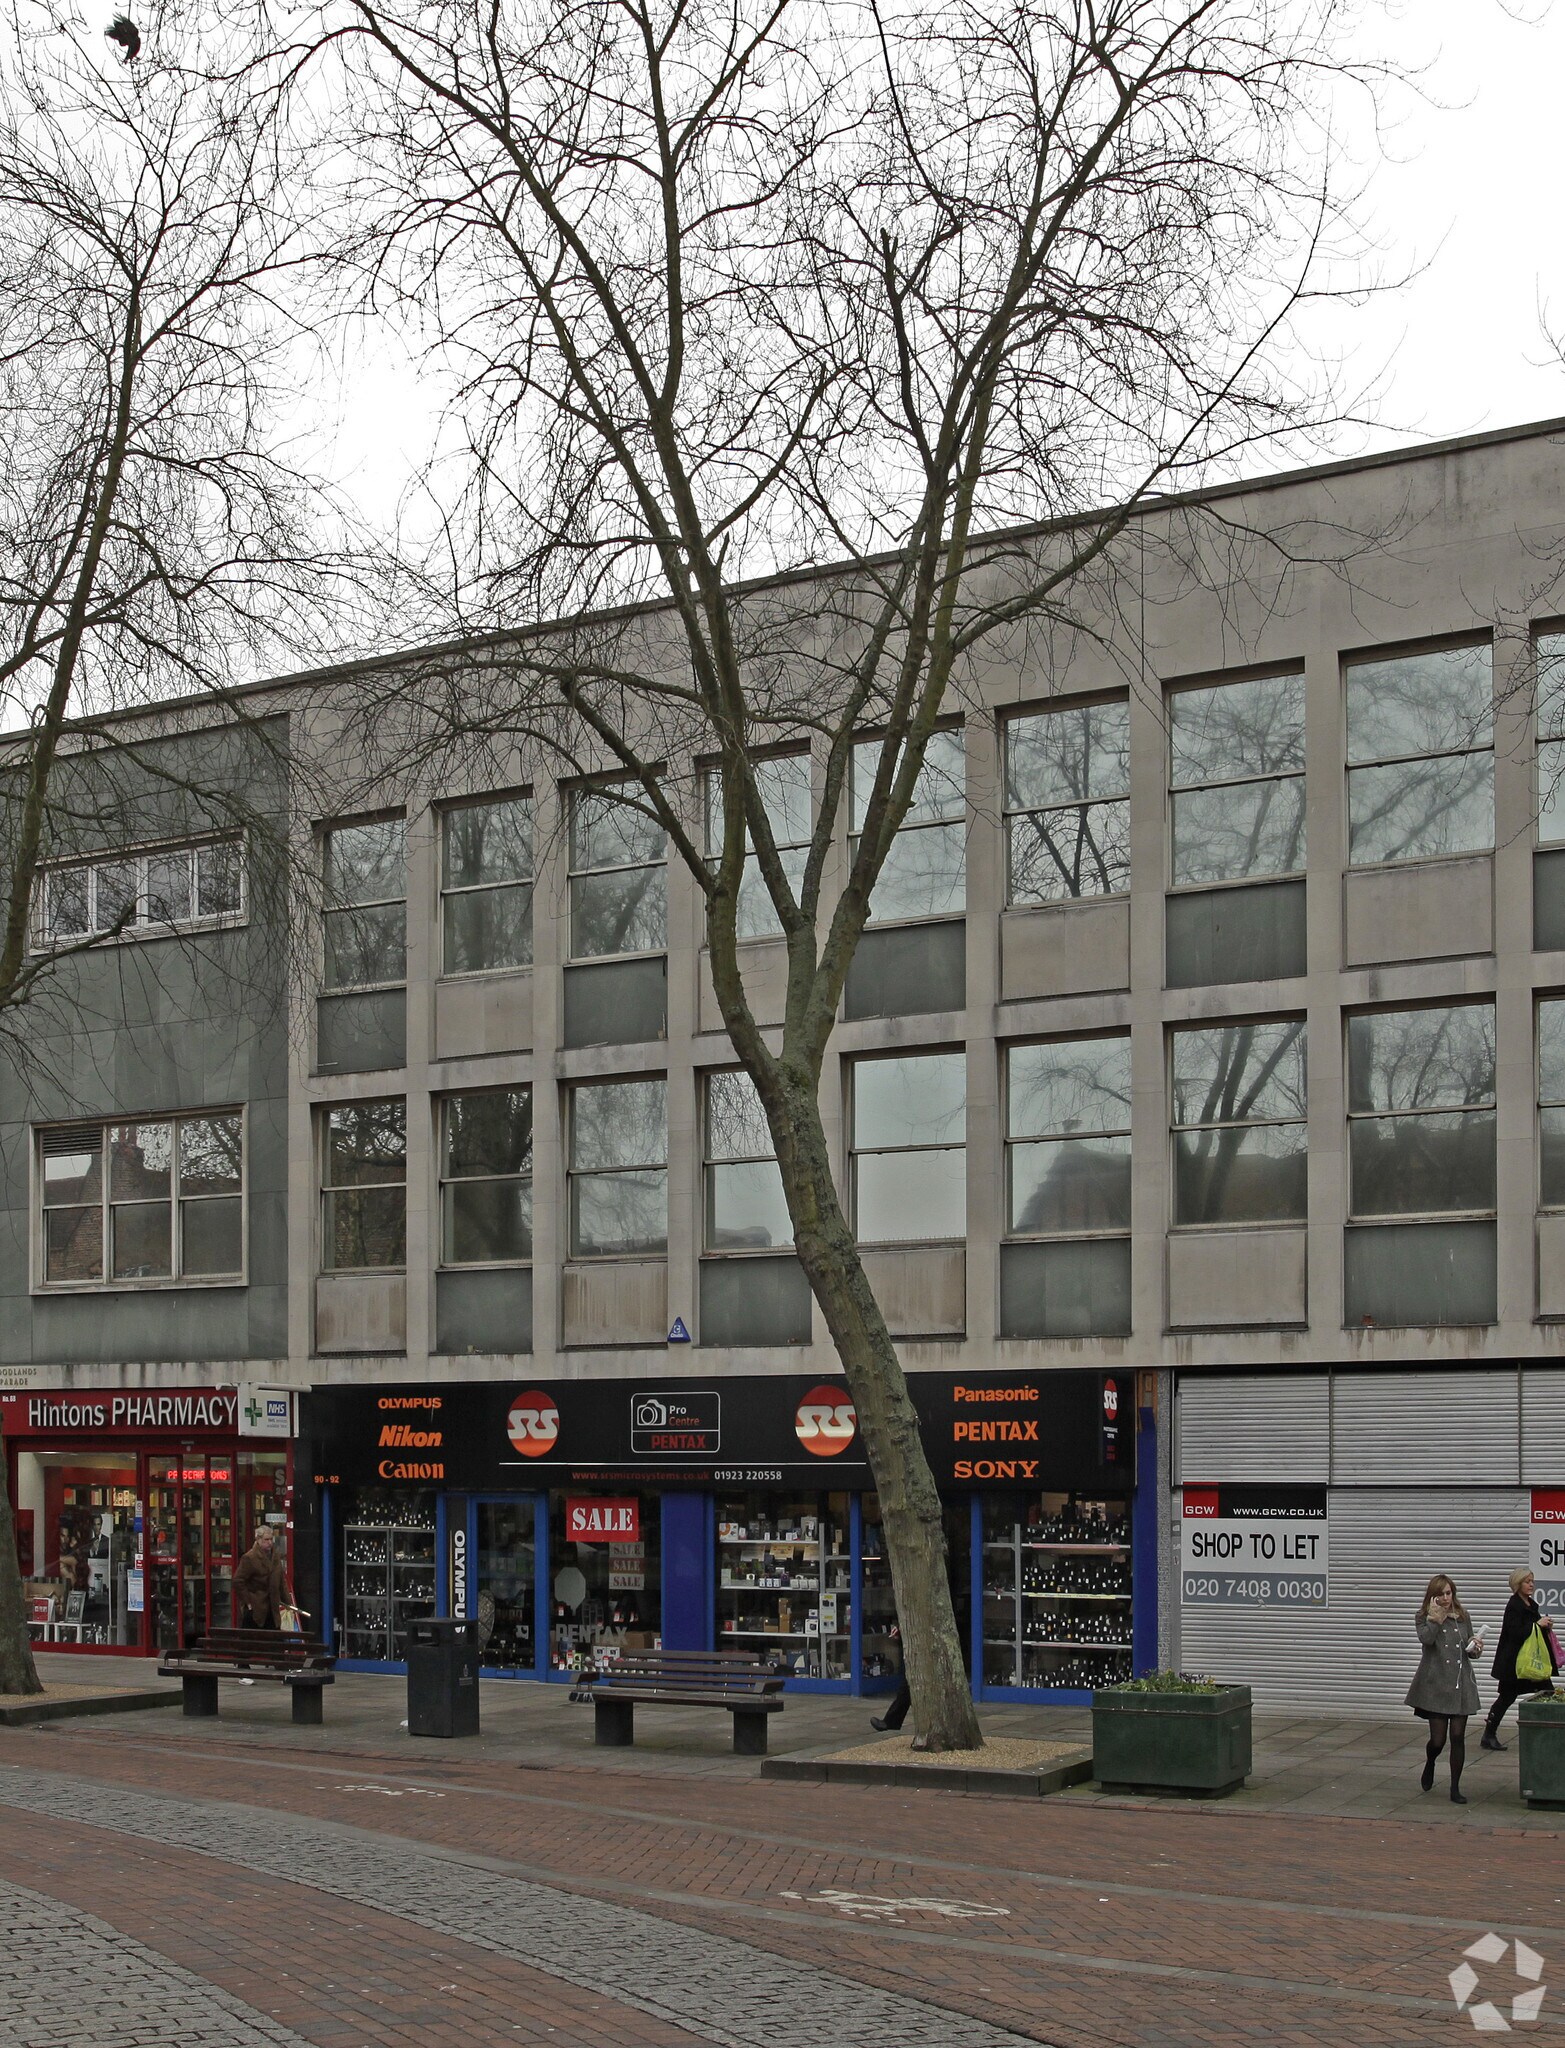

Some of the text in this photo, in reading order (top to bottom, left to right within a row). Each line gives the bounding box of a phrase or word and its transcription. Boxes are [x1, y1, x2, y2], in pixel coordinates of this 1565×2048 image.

[953, 1385, 1039, 1402] Panasonic
[268, 1403, 286, 1414] NHS
[378, 1397, 442, 1409] OLYMPUS
[669, 1405, 687, 1414] Pro
[28, 1396, 237, 1427] Hintons PHARMACY
[668, 1416, 701, 1427] Centre
[378, 1425, 443, 1448] Nikon
[953, 1421, 1039, 1442] PENTAX
[651, 1434, 707, 1450] PENTAX
[378, 1460, 444, 1479] Canon
[714, 1471, 743, 1480] 01923
[746, 1471, 782, 1480] 220558
[953, 1461, 1039, 1479] SONY
[314, 1475, 324, 1484] 90
[329, 1475, 340, 1484] 92
[572, 1507, 633, 1531] SALE
[1185, 1505, 1324, 1517] GCW WWW.GCW.CO.UK
[613, 1543, 641, 1556] SALE
[1191, 1532, 1320, 1561] SHOP TO LET
[613, 1559, 641, 1571] SALE
[613, 1575, 641, 1587] SALE
[1185, 1578, 1324, 1600] 020 7408 0030
[555, 1624, 628, 1645] PENTAX
